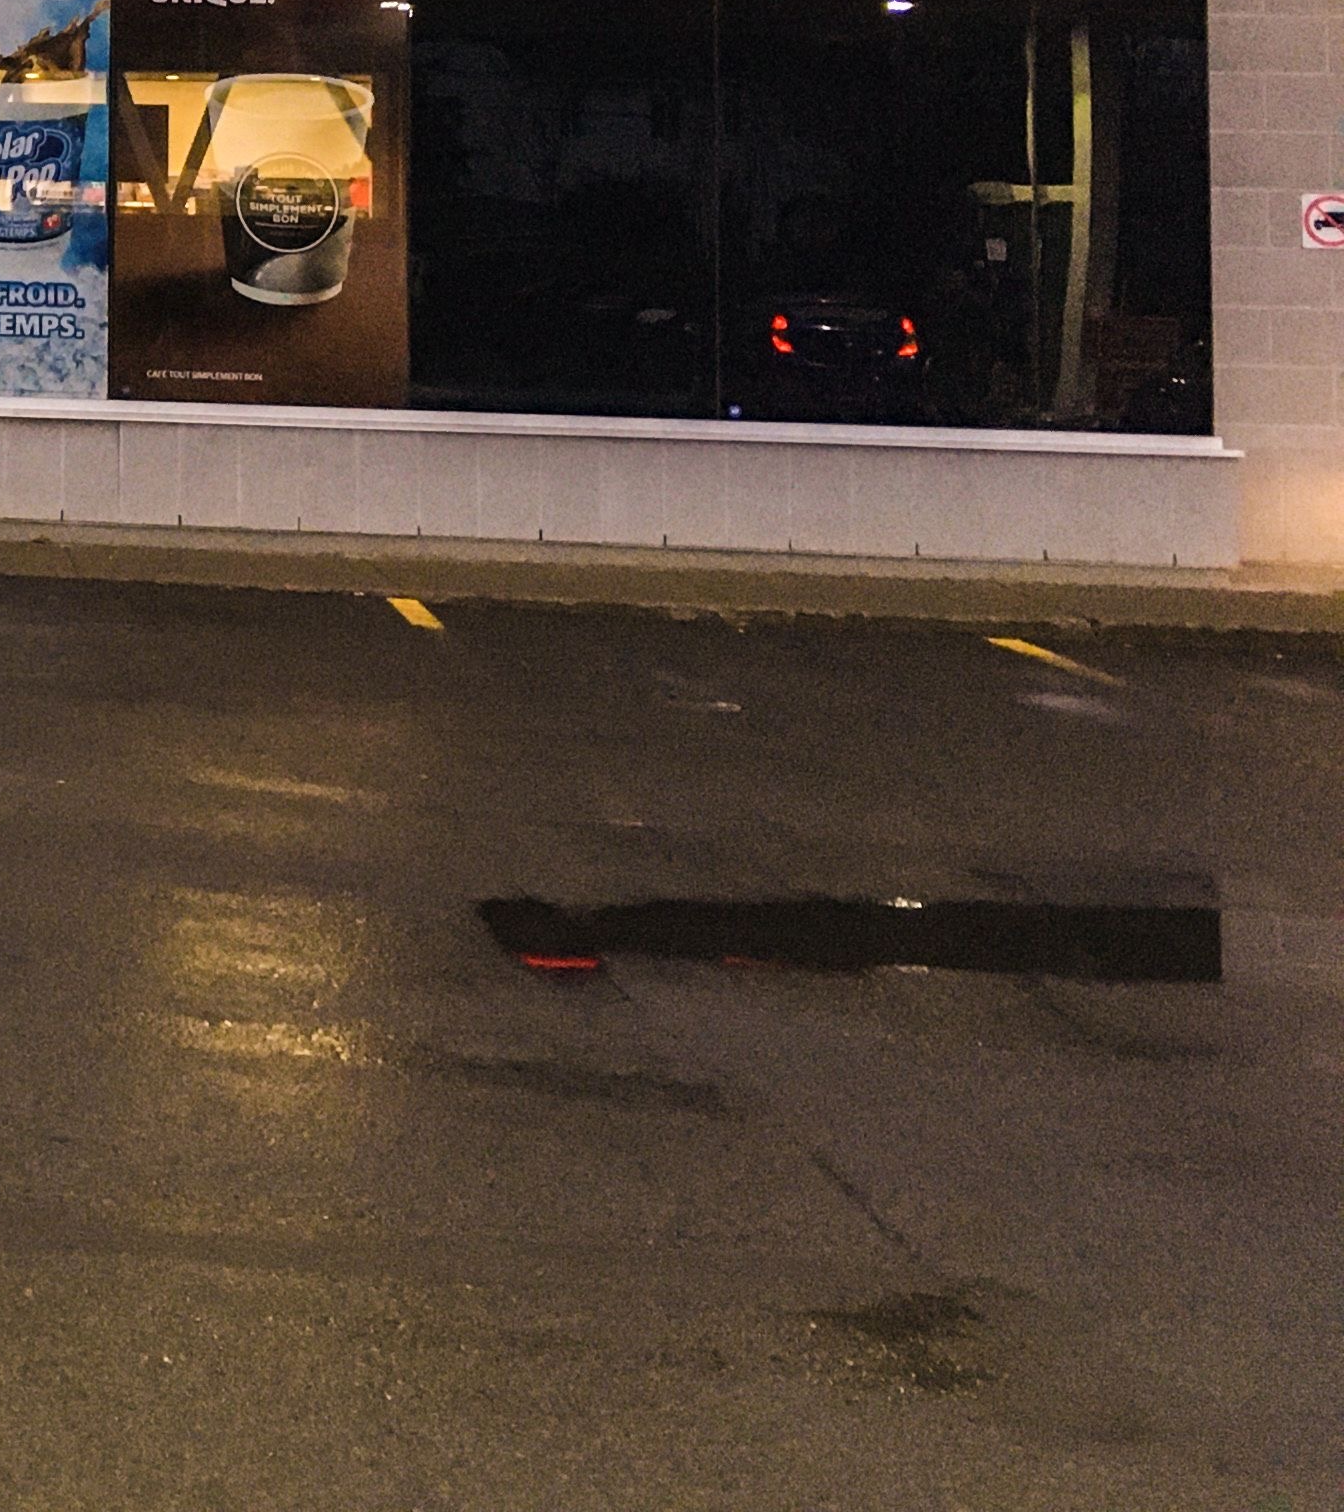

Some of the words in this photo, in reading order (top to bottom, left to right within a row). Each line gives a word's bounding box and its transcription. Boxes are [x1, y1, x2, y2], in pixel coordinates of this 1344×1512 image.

[7, 162, 56, 202] Pop
[271, 194, 303, 204] TOUT
[249, 202, 323, 215] SIMPLEMENT
[272, 214, 299, 224] BON
